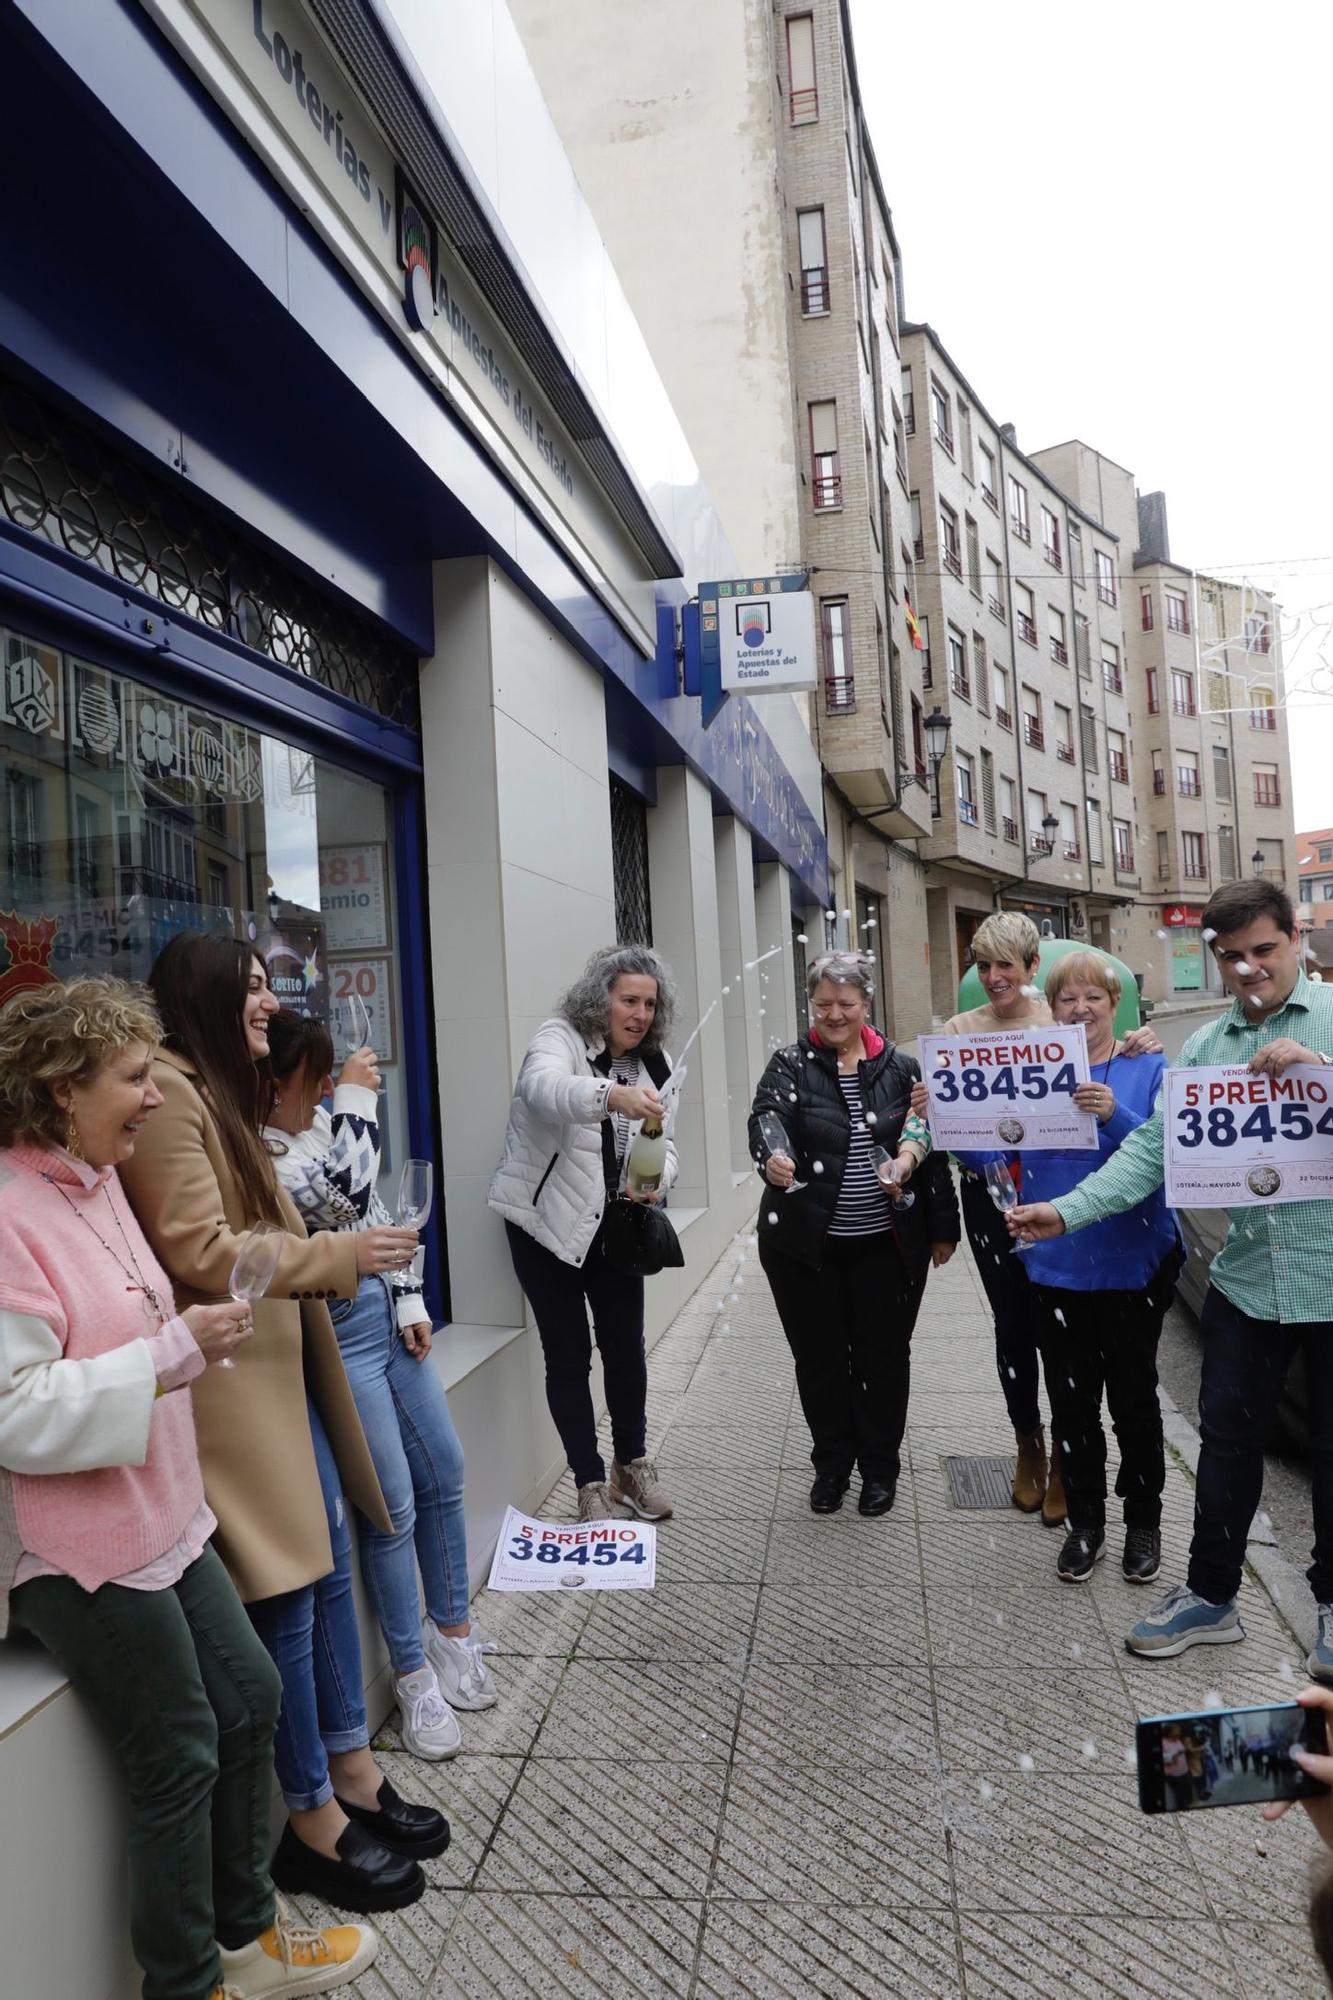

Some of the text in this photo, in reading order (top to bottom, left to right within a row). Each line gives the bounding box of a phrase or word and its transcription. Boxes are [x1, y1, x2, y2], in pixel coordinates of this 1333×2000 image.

[437, 273, 511, 408] Apuestas
[513, 388, 534, 442] del
[535, 418, 574, 497] Estado
[738, 656, 797, 669] Apuestas del
[776, 648, 783, 657] y
[738, 669, 770, 679] Estado
[320, 890, 371, 910] emio
[271, 977, 303, 992] SORTEO
[329, 967, 377, 998] 20
[969, 1034, 1025, 1044] VENDIDO AQUÍ
[959, 1042, 1065, 1067] PREMIO
[932, 1063, 1081, 1102] 38454
[1185, 1078, 1328, 1106] 5º PREMIO
[520, 1525, 637, 1544] 5º PREMIO
[508, 1537, 647, 1566] 38454
